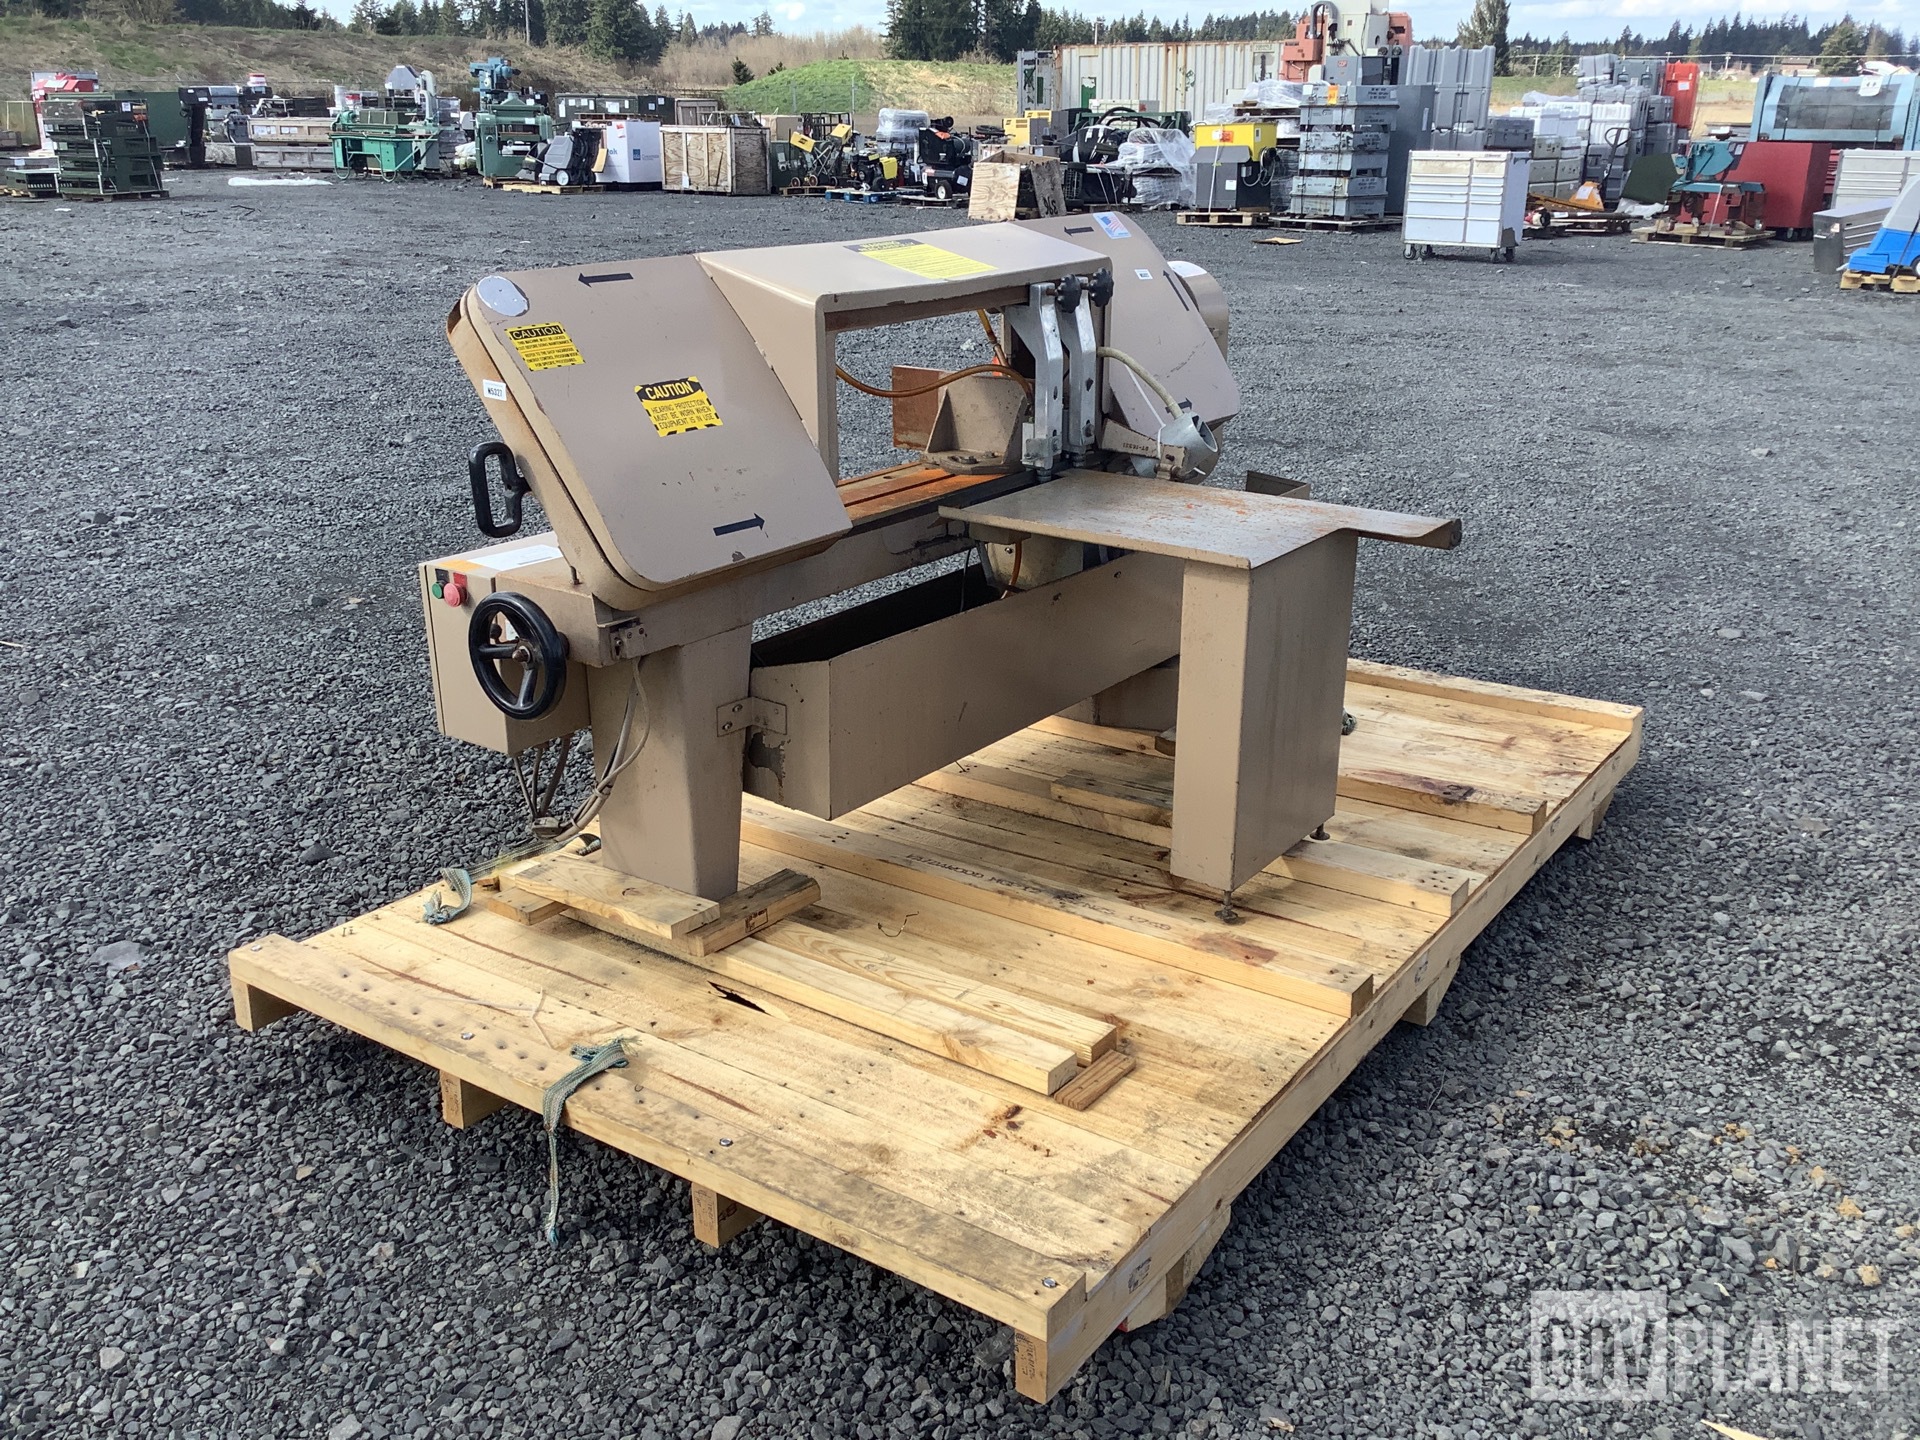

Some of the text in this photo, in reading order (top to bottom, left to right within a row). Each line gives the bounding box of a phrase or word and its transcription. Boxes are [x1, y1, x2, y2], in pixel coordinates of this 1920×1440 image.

[512, 326, 562, 339] CAUTION
[645, 381, 694, 399] CAUTION
[651, 399, 706, 414] HEARING PROTECTION
[653, 405, 712, 422] MUST BE WORN WHEN
[658, 413, 716, 430] EQUIPMENT IS IN USE
